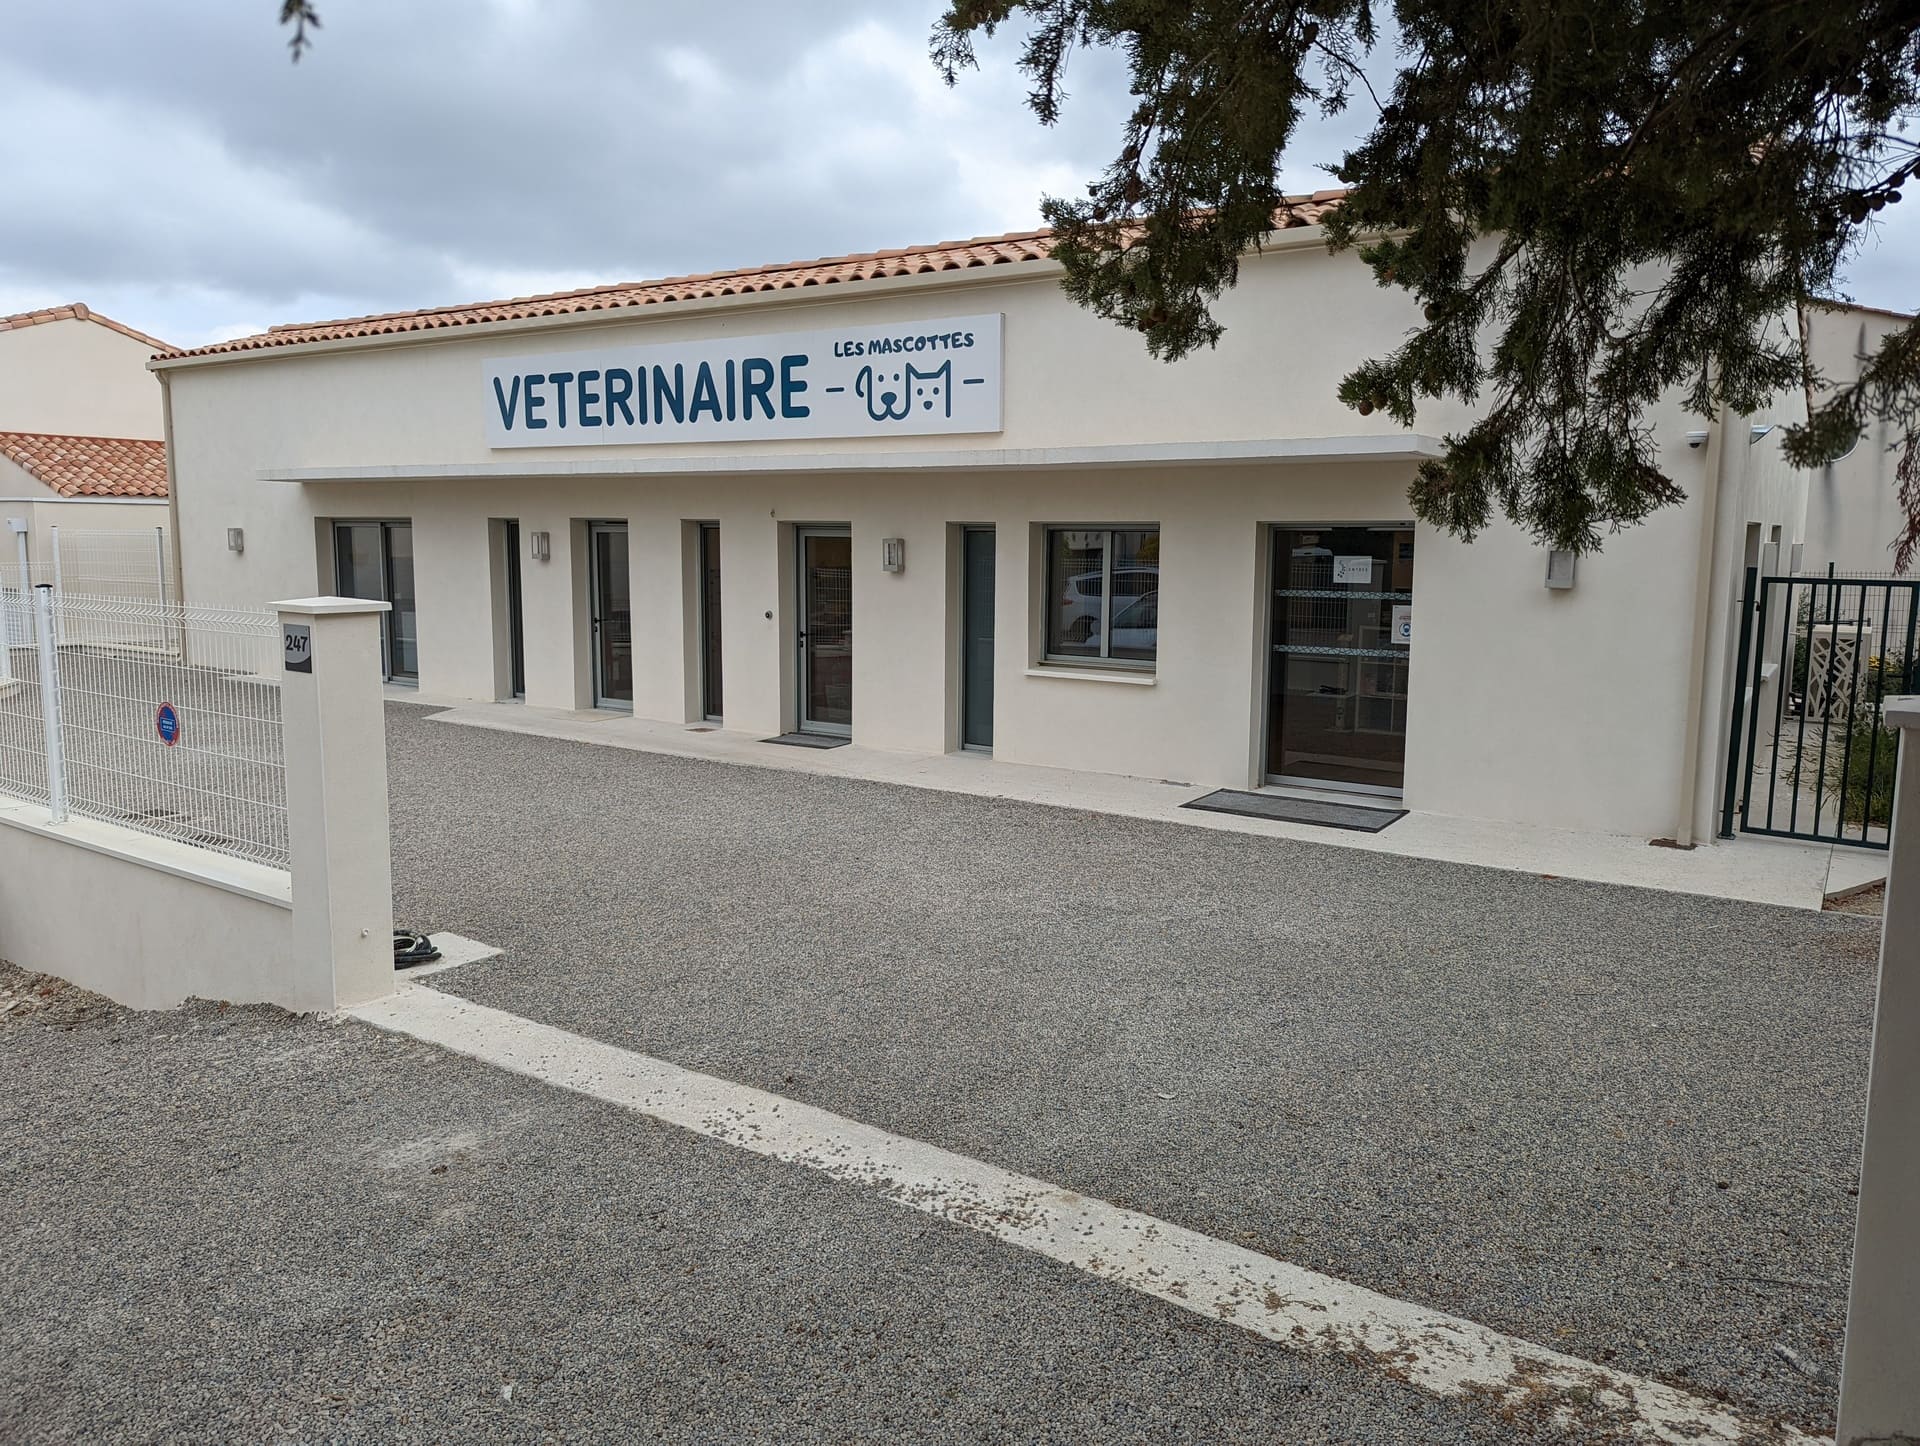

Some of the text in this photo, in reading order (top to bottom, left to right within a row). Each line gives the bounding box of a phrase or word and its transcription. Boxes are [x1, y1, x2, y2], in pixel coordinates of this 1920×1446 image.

[834, 331, 975, 358] LES MASCOTTES
[492, 354, 811, 431] VETERINAIRE
[285, 634, 308, 652] 247
